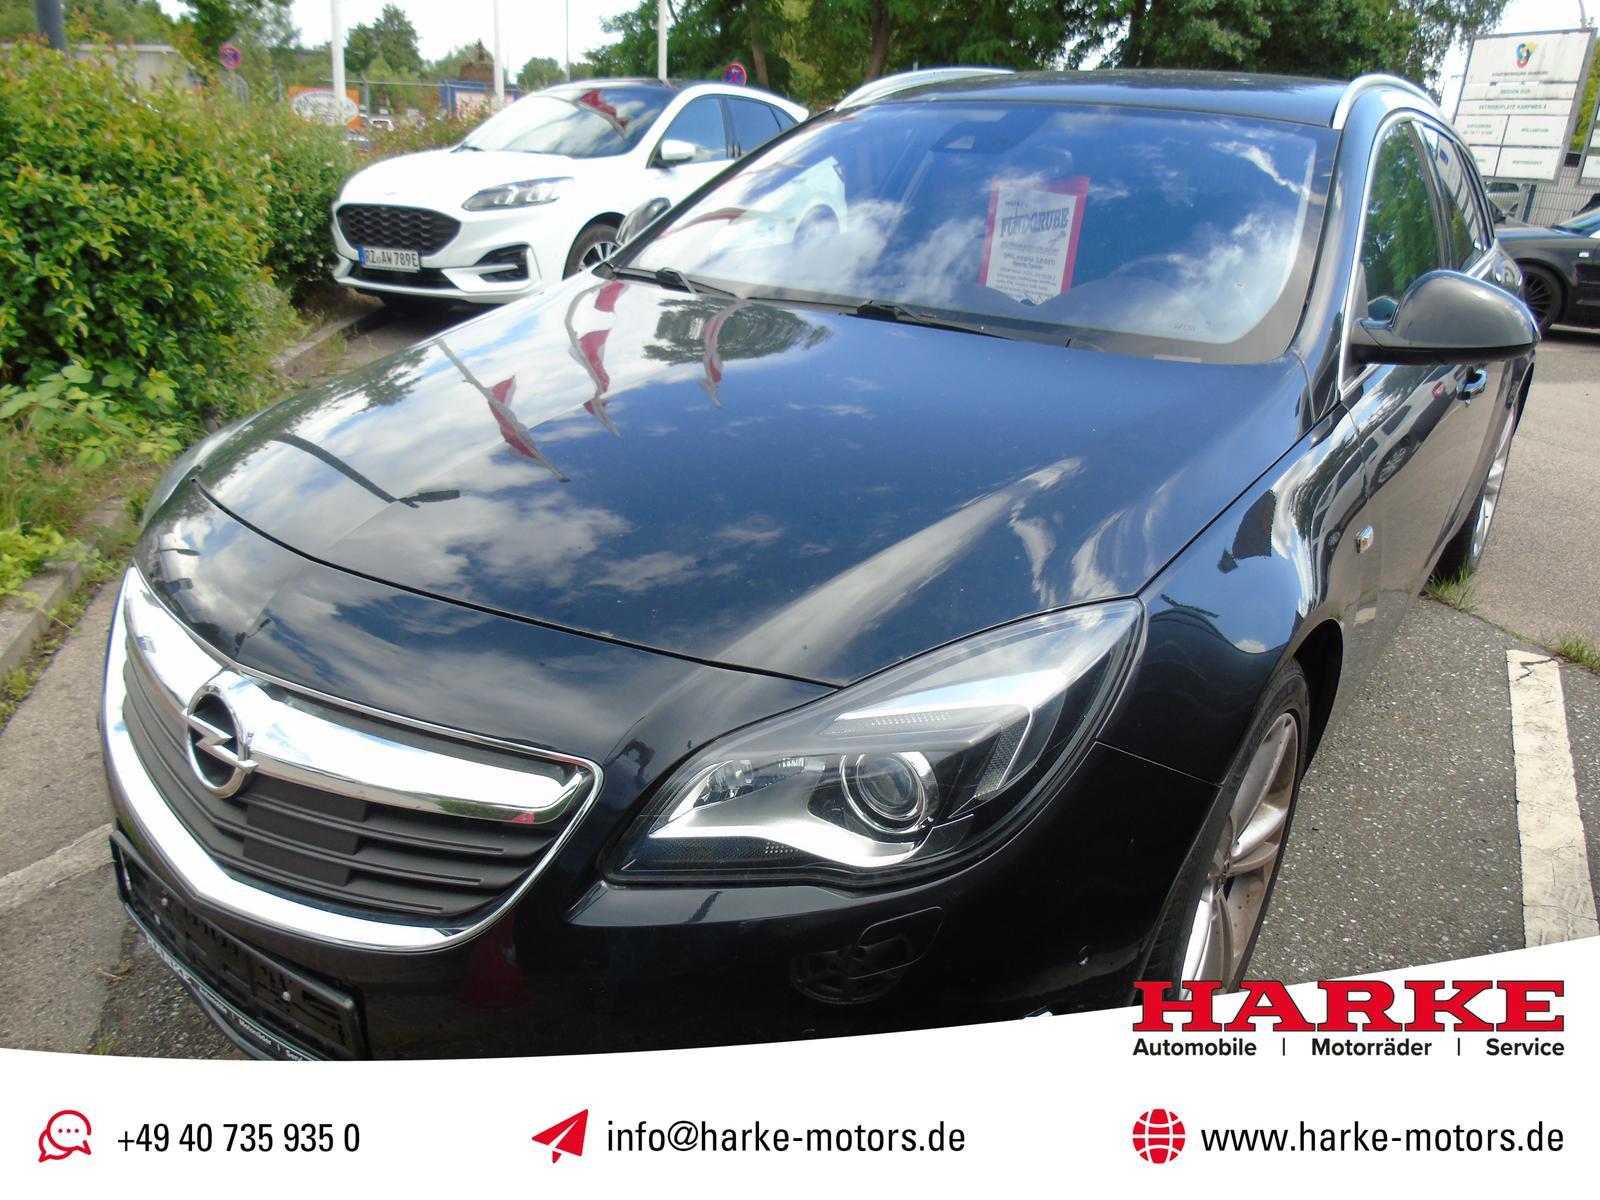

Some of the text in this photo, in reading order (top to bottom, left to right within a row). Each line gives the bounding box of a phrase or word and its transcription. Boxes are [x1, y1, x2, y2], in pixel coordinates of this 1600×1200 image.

[1000, 208, 1069, 238] FUNDGRUBE
[365, 250, 418, 267] RZ AW 789E
